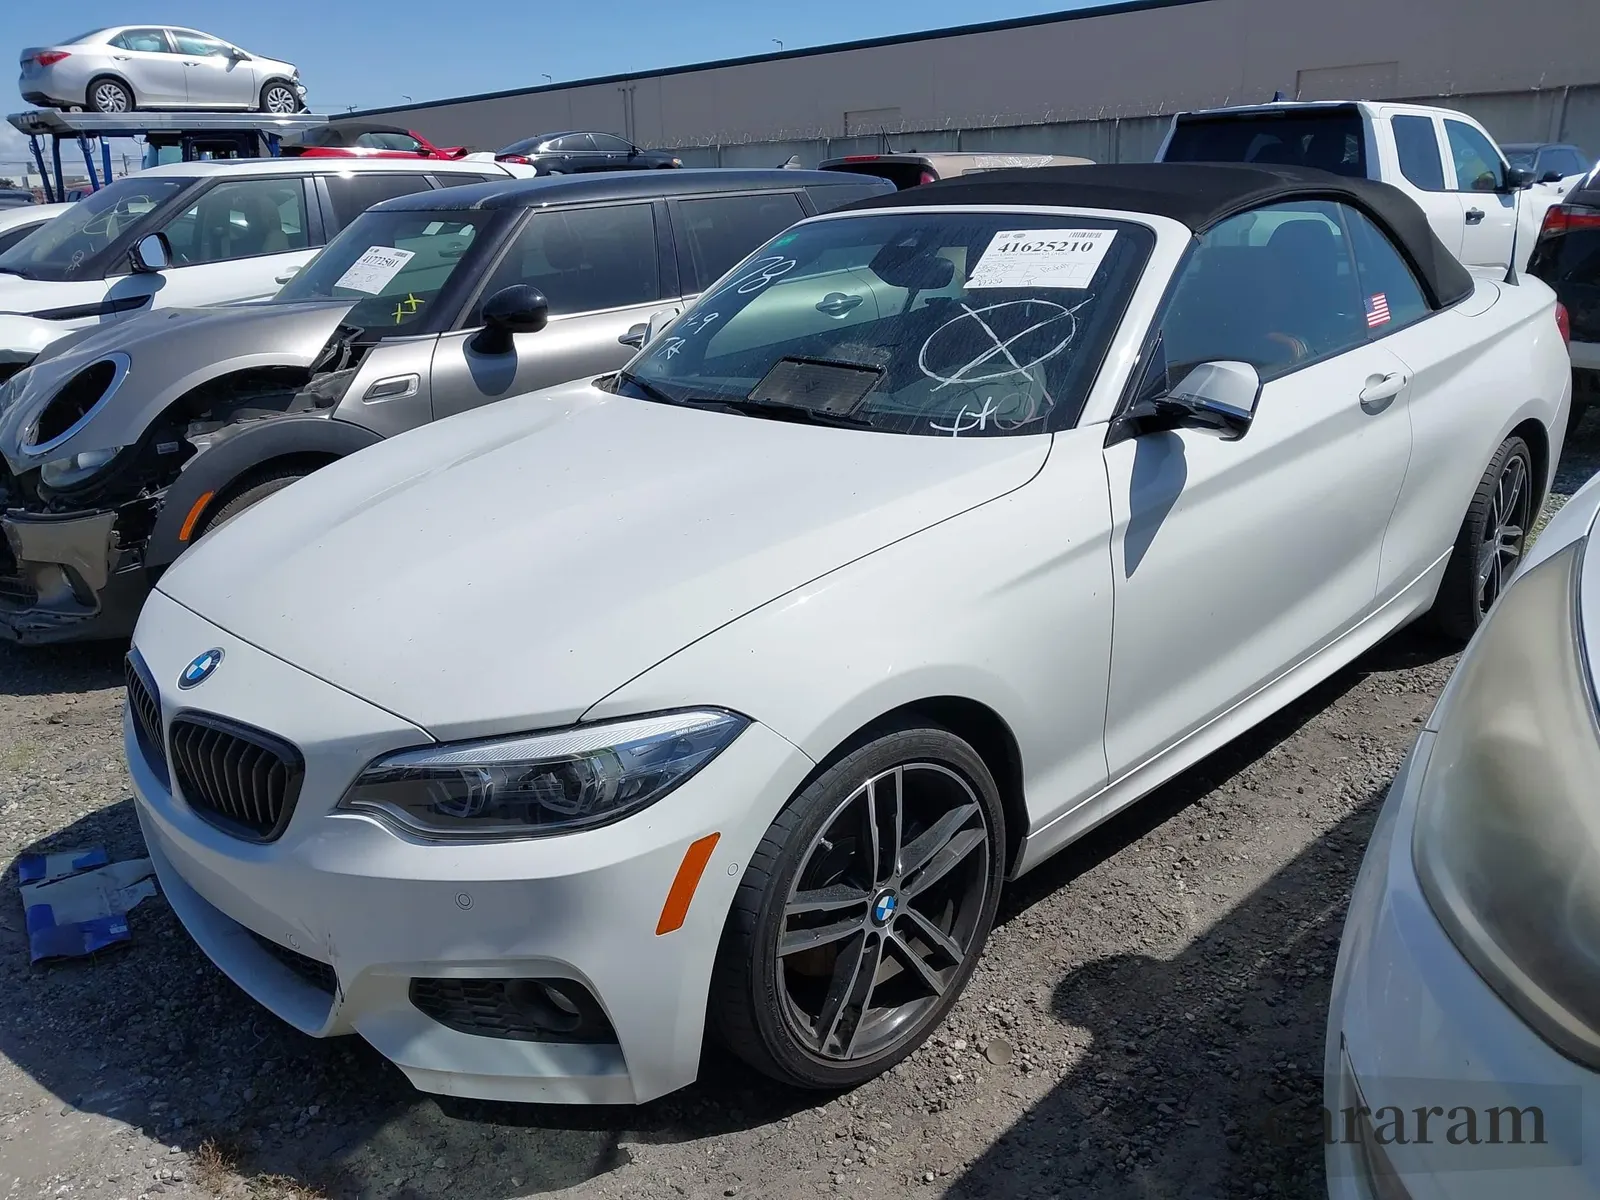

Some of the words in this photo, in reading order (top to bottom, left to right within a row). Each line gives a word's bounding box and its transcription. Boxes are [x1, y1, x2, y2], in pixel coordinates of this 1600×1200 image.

[998, 241, 1093, 253] 41625210
[362, 255, 400, 267] 41772501
[707, 720, 717, 728] LED
